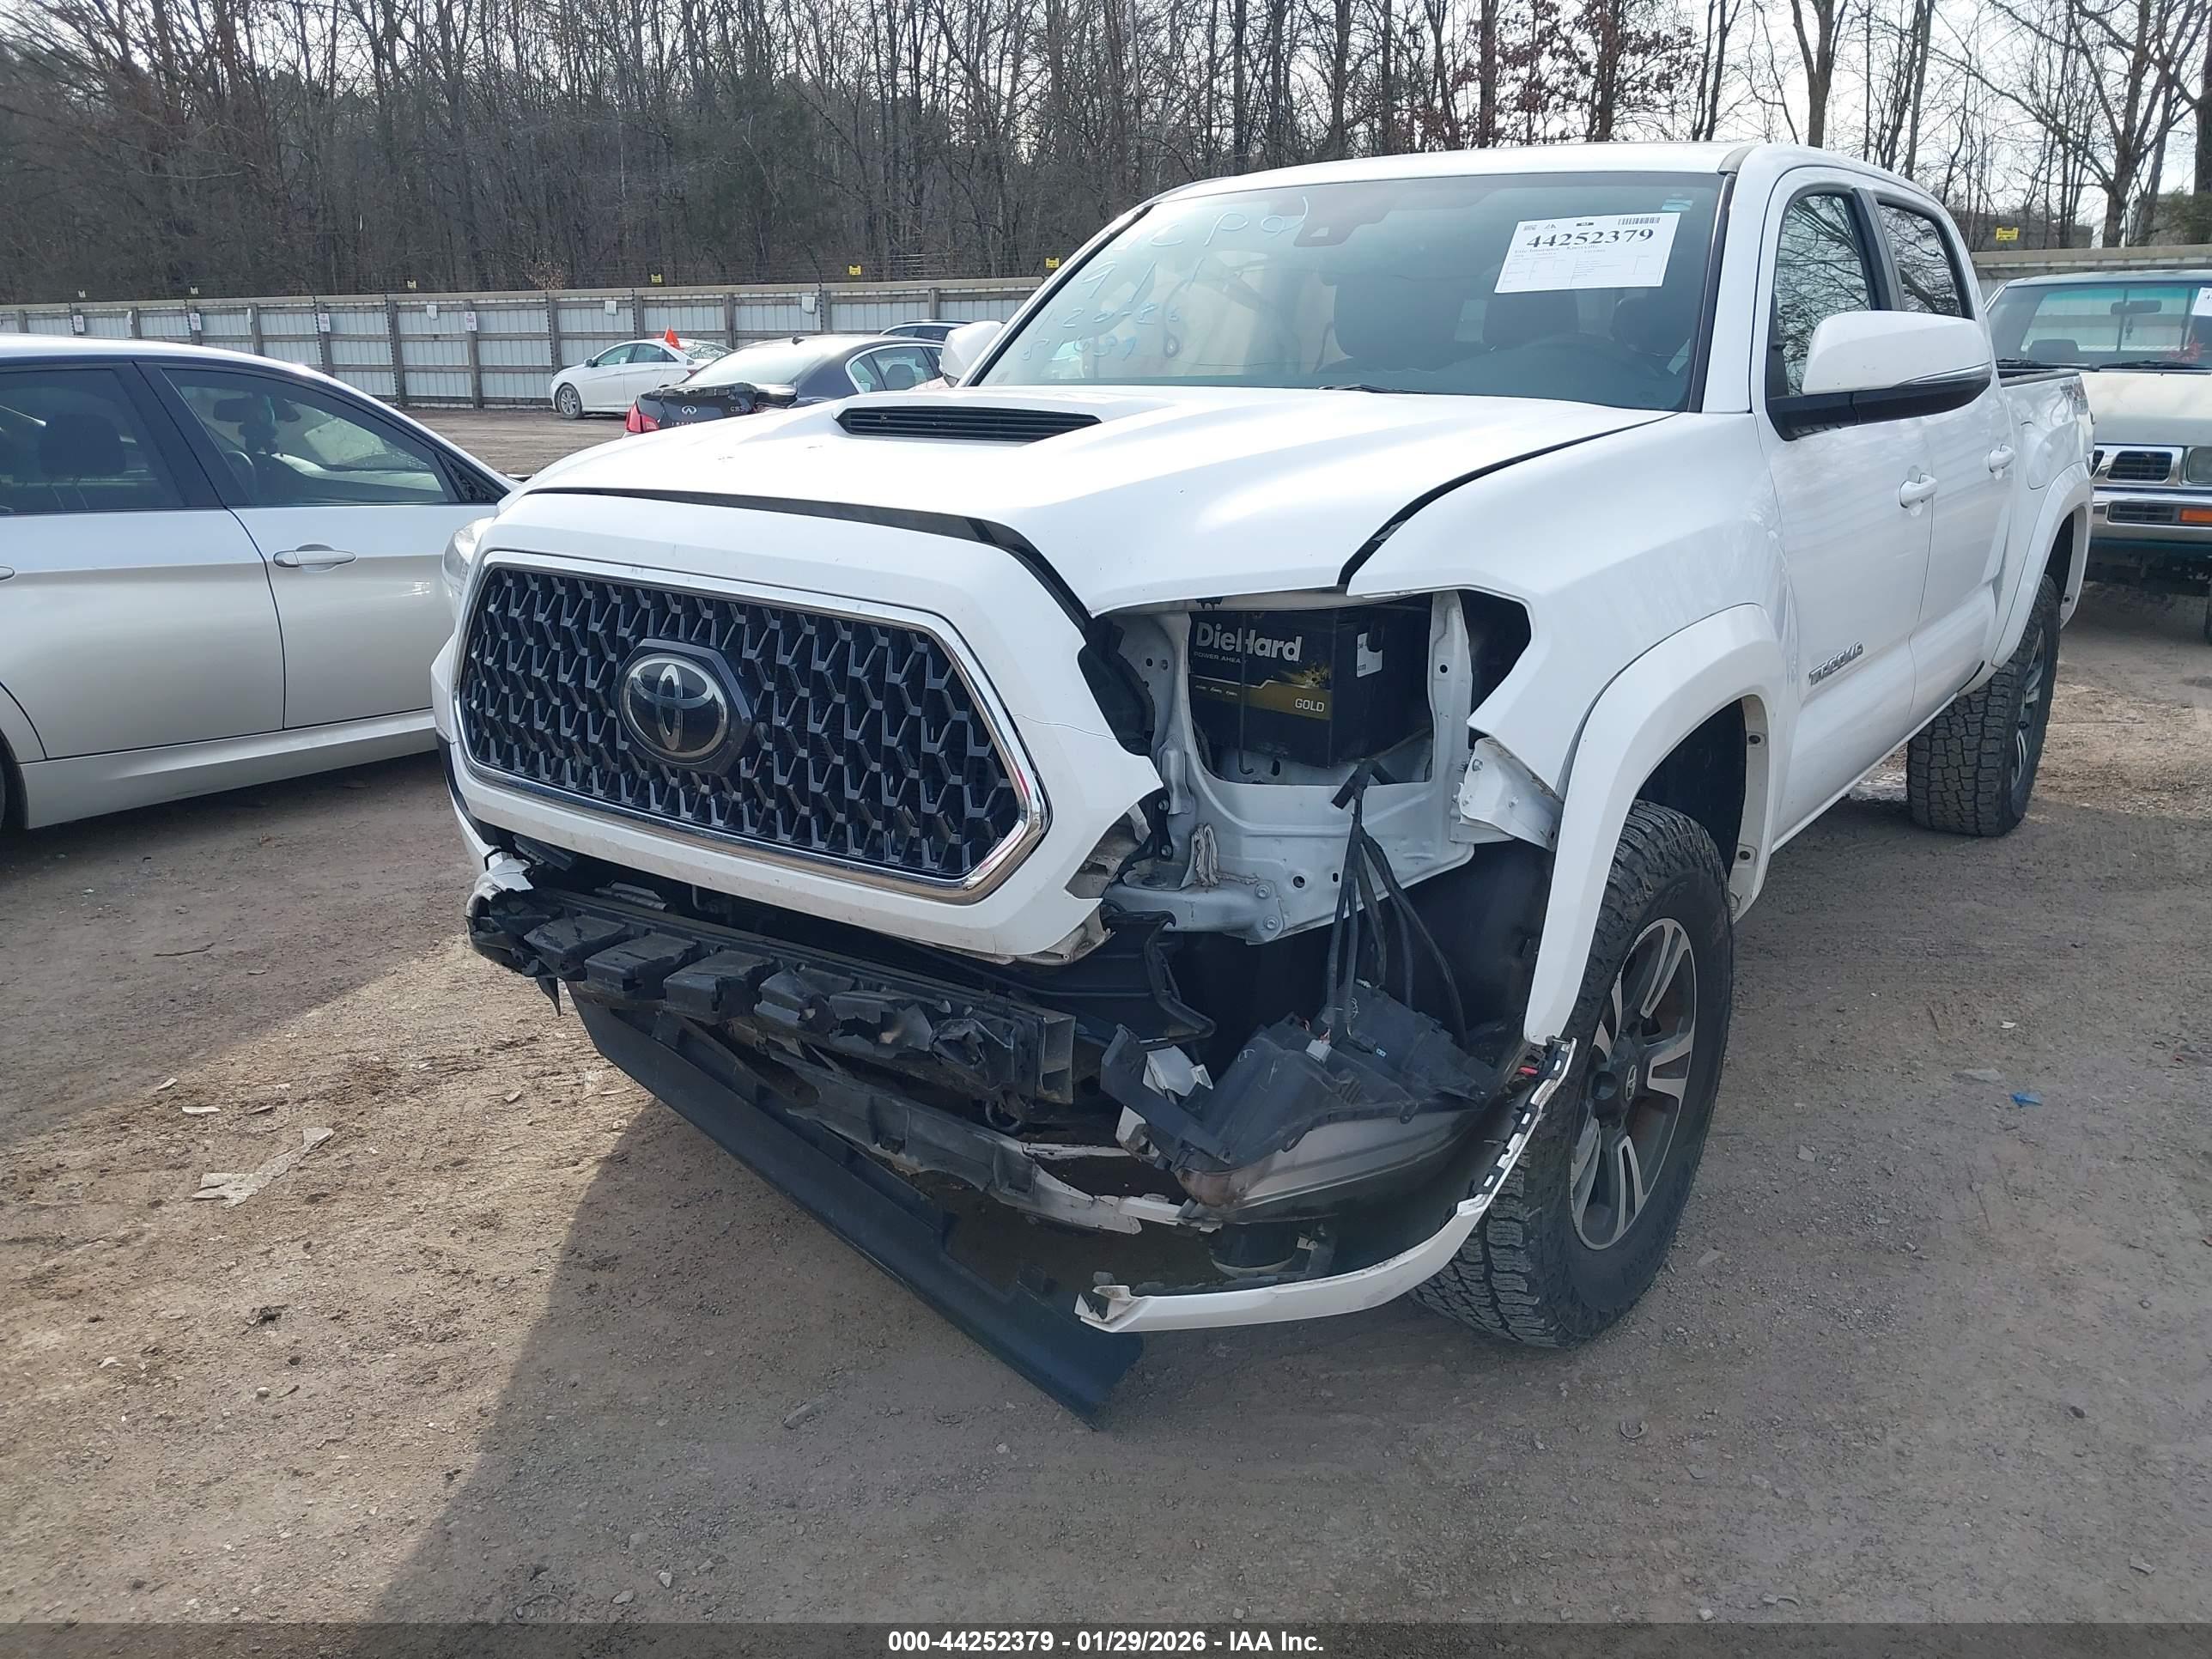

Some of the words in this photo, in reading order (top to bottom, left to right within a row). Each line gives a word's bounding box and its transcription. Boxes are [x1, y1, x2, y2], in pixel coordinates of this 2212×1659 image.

[1527, 228, 1654, 248] 44252379
[1195, 622, 1303, 662] DieHard
[1194, 651, 1219, 660] POWER
[1221, 655, 1244, 664] AHEA
[1295, 698, 1325, 713] GOLD
